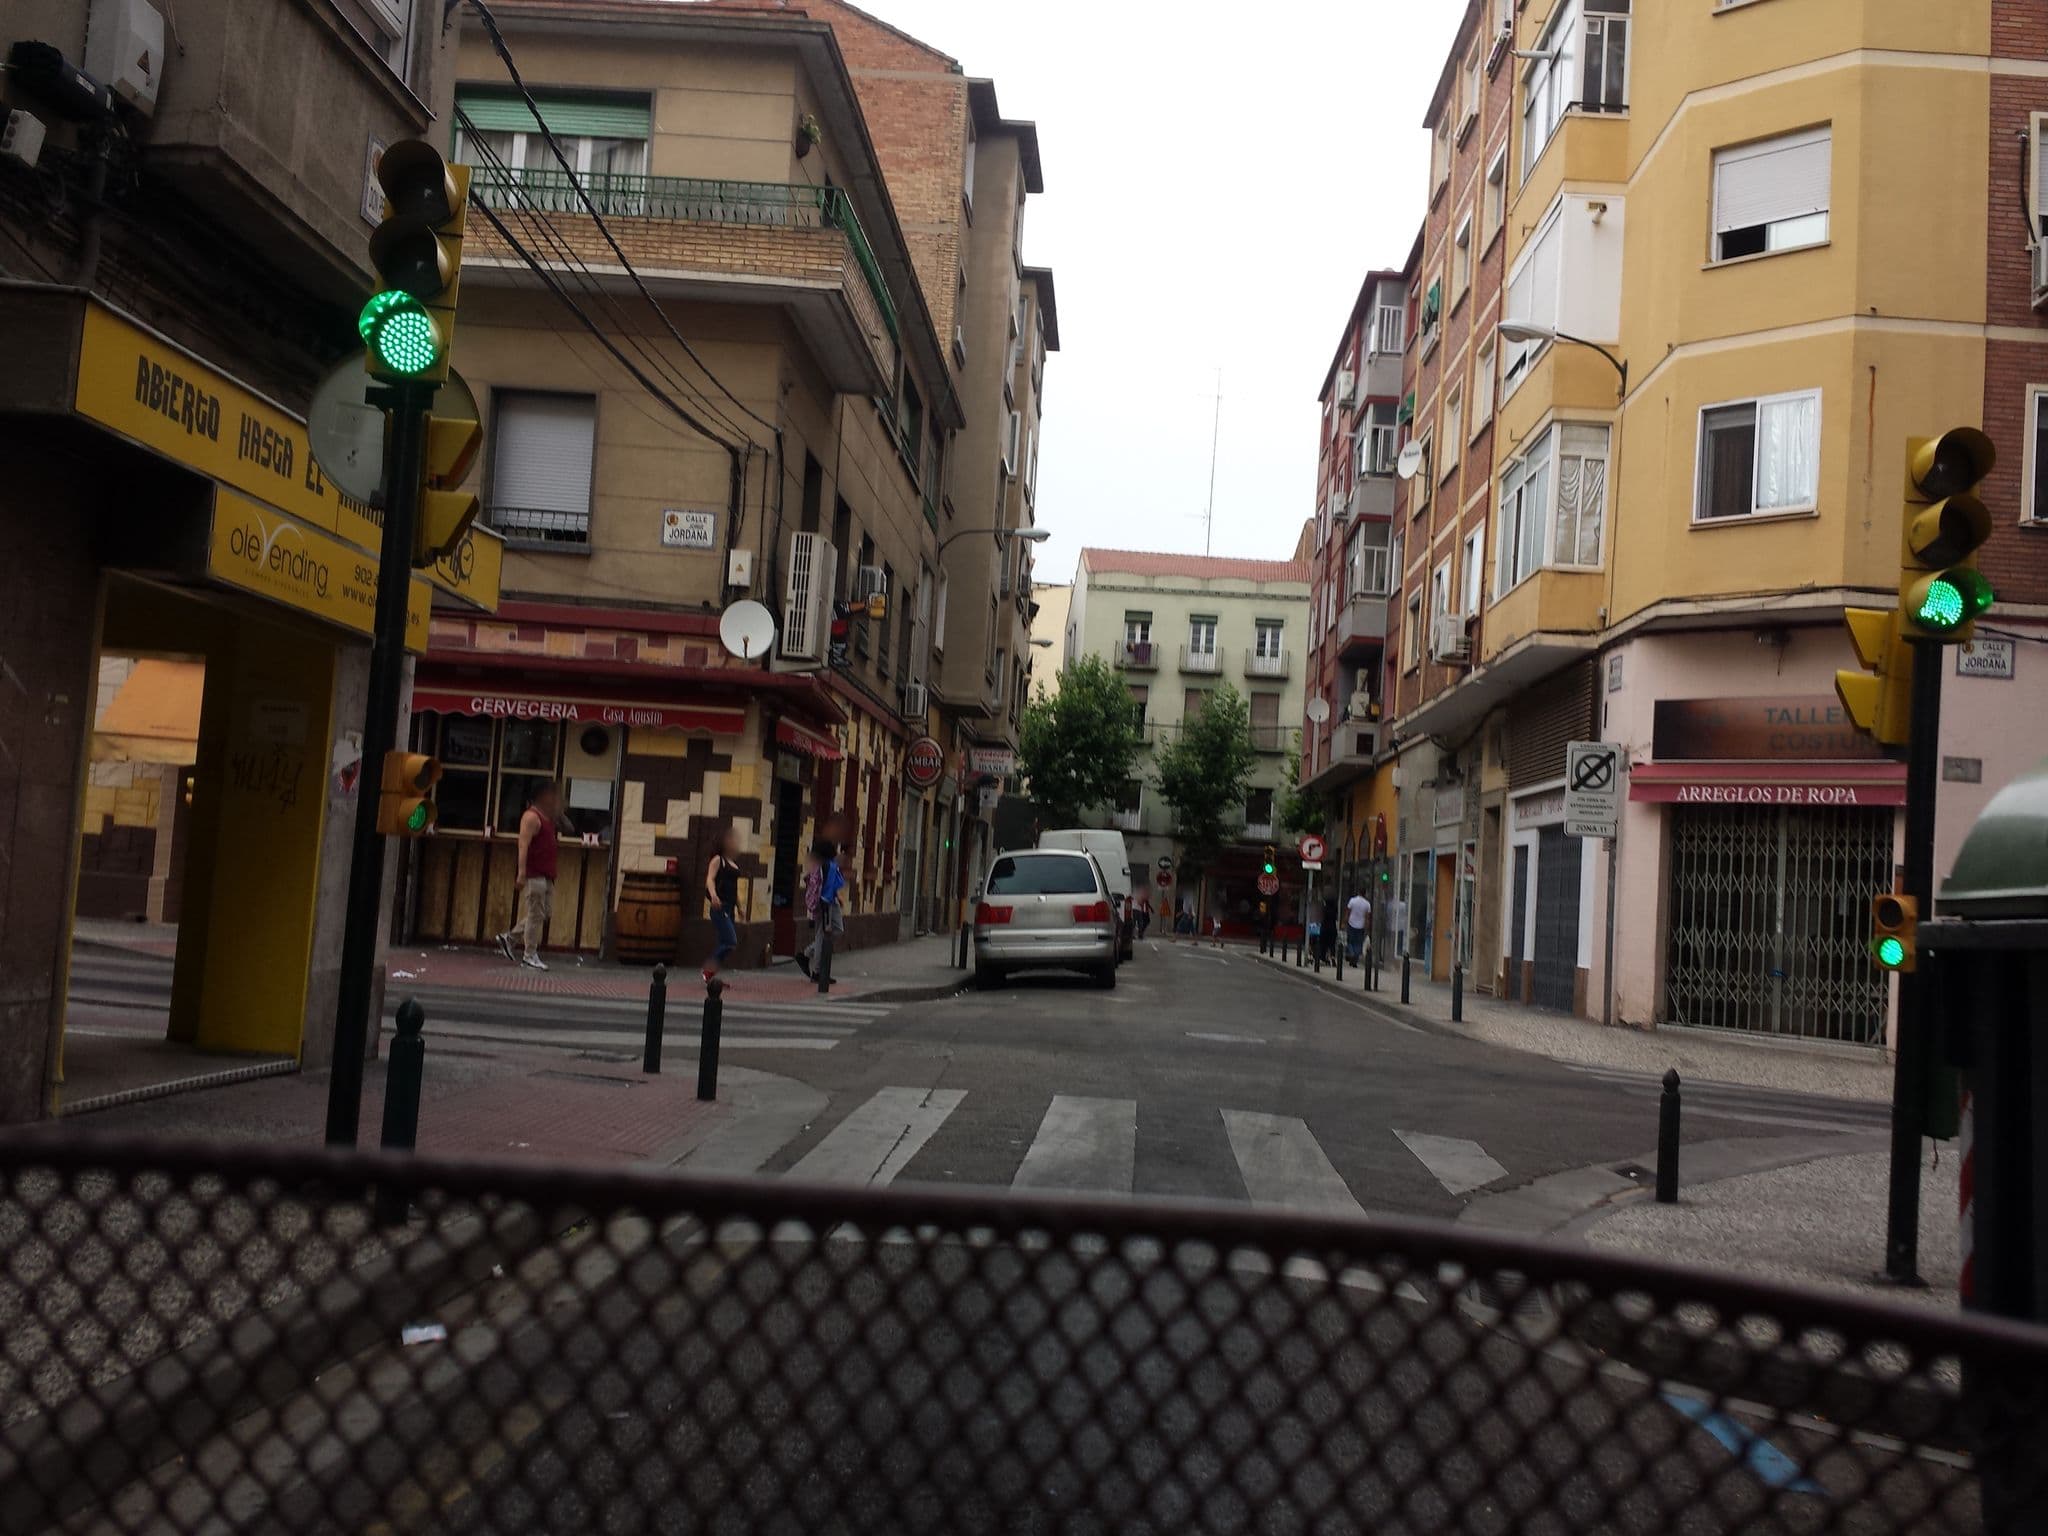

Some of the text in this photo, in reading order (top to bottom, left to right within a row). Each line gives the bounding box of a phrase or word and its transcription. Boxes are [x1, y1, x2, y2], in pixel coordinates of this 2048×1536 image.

[685, 514, 706, 524] CALLE
[669, 528, 708, 541] JORDANA
[354, 564, 373, 586] 902
[342, 583, 377, 608] www.ol
[1982, 641, 2005, 651] CALLE
[1965, 656, 2007, 670] JORDANA
[470, 697, 579, 719] CERVECERIA
[603, 706, 624, 723] Casa
[1769, 732, 1875, 752] COSTUR
[907, 756, 942, 769] AMBAR
[1676, 786, 1859, 804] ARREGLOS DE ROPA
[1575, 823, 1598, 833] ZONA
